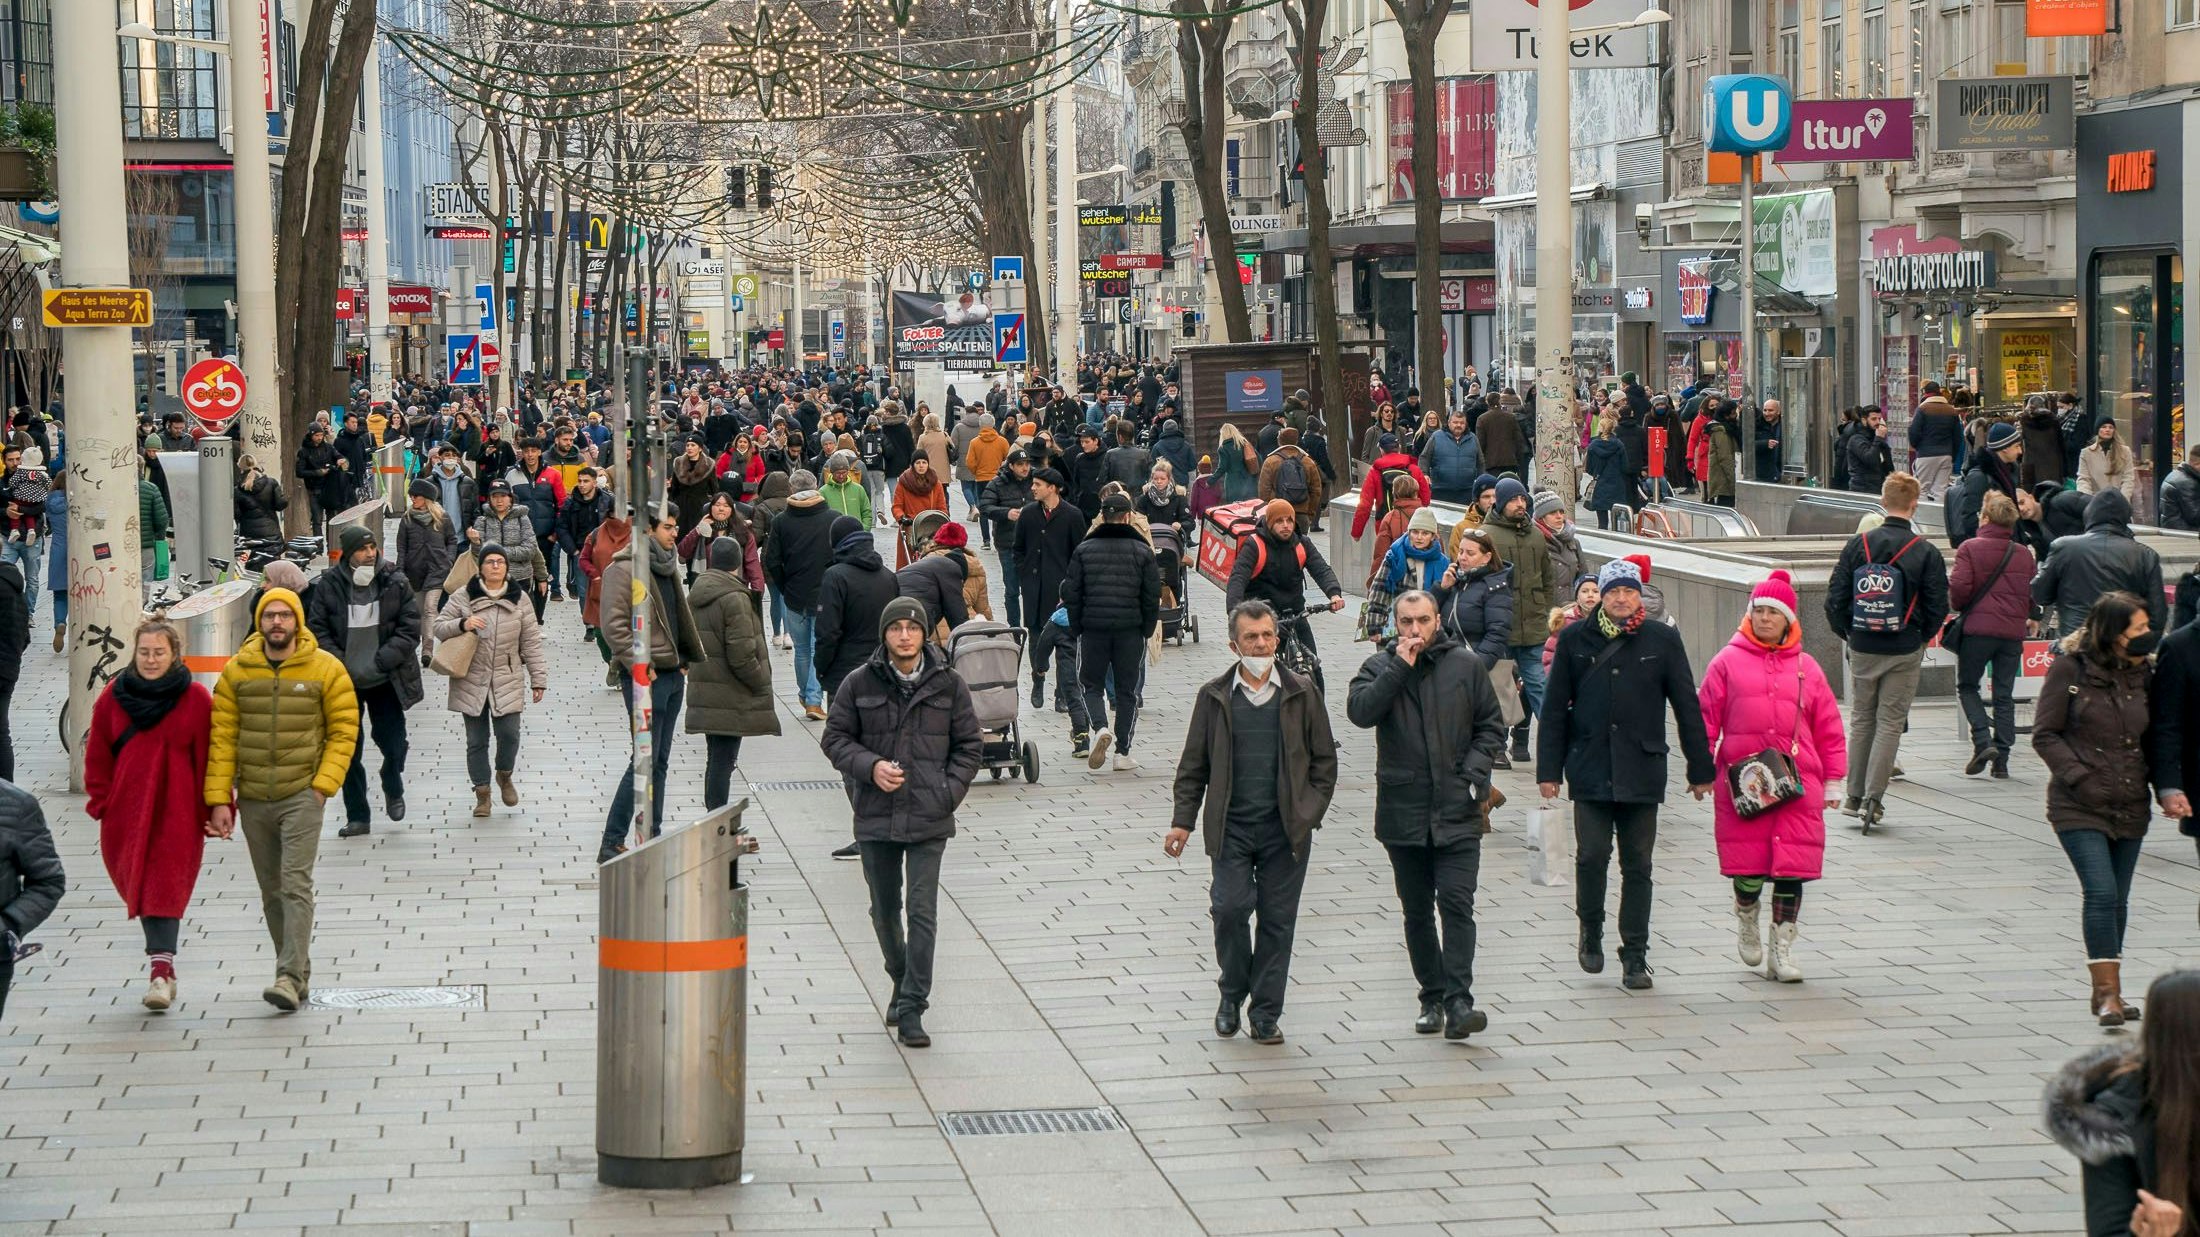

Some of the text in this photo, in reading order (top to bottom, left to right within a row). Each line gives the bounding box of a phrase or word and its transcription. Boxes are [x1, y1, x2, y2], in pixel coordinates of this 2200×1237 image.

[1505, 28, 1613, 58] Tuek
[1959, 83, 2049, 116] BORTOLOTTI
[1732, 91, 1779, 141] U
[1968, 96, 2046, 135] Paolo
[1803, 119, 1866, 150] ltur
[437, 187, 517, 214] STADTSL
[1080, 208, 1109, 217] sehen!
[1081, 215, 1125, 225] wutscher
[1116, 256, 1147, 267] CAMPER
[1082, 270, 1129, 279] wutscher
[1873, 251, 1985, 292] PAOLO BORTOLOTTI
[1440, 280, 1460, 301] AG
[61, 295, 129, 306] Haus des Meeres
[1682, 289, 1708, 316] SHOP
[65, 308, 126, 320] Aqua Terra Zoo
[903, 327, 944, 341] FOLTER
[2003, 334, 2051, 346] AKTION
[2003, 349, 2050, 358] LAMMFELL
[946, 359, 992, 370] TIERFABRIKEN
[197, 388, 232, 401] citybike
[202, 446, 225, 458] 601
